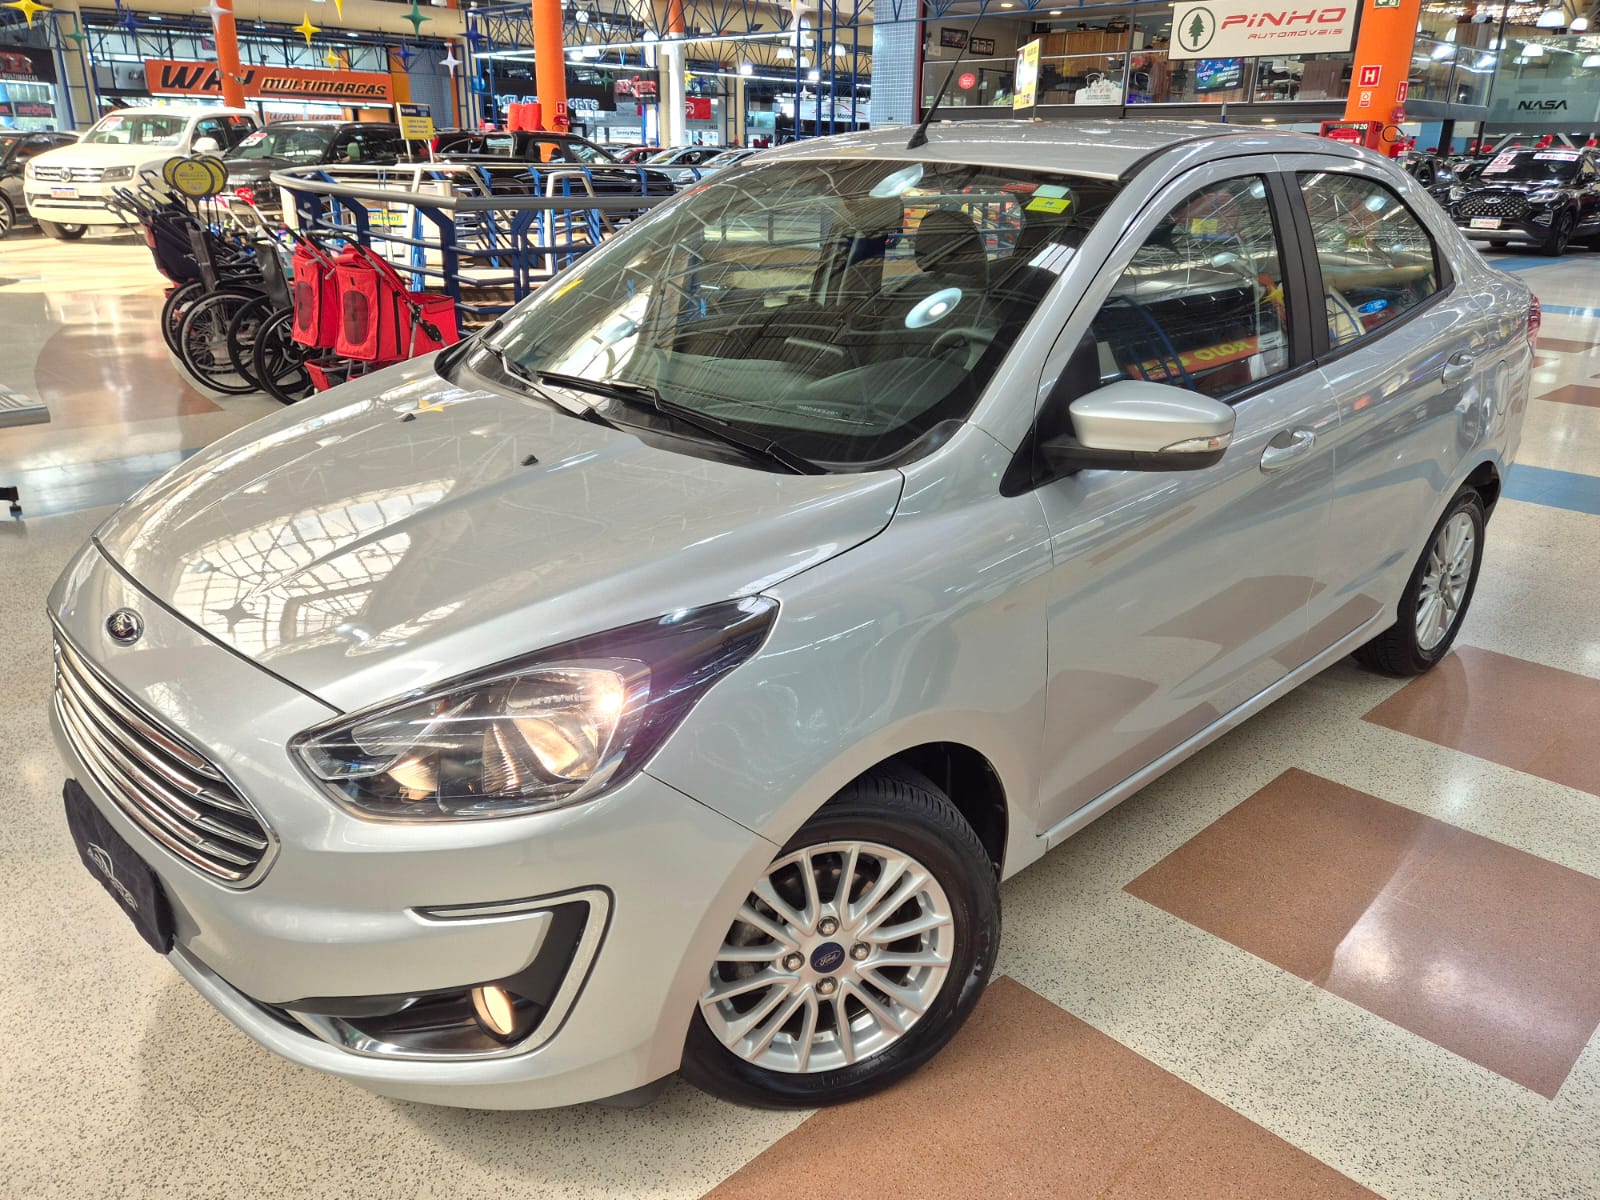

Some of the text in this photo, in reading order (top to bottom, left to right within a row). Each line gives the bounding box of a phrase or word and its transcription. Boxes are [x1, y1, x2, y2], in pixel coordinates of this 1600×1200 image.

[1364, 70, 1376, 82] H
[262, 77, 386, 95] MULTIMARCAS
[1518, 100, 1567, 110] NASA
